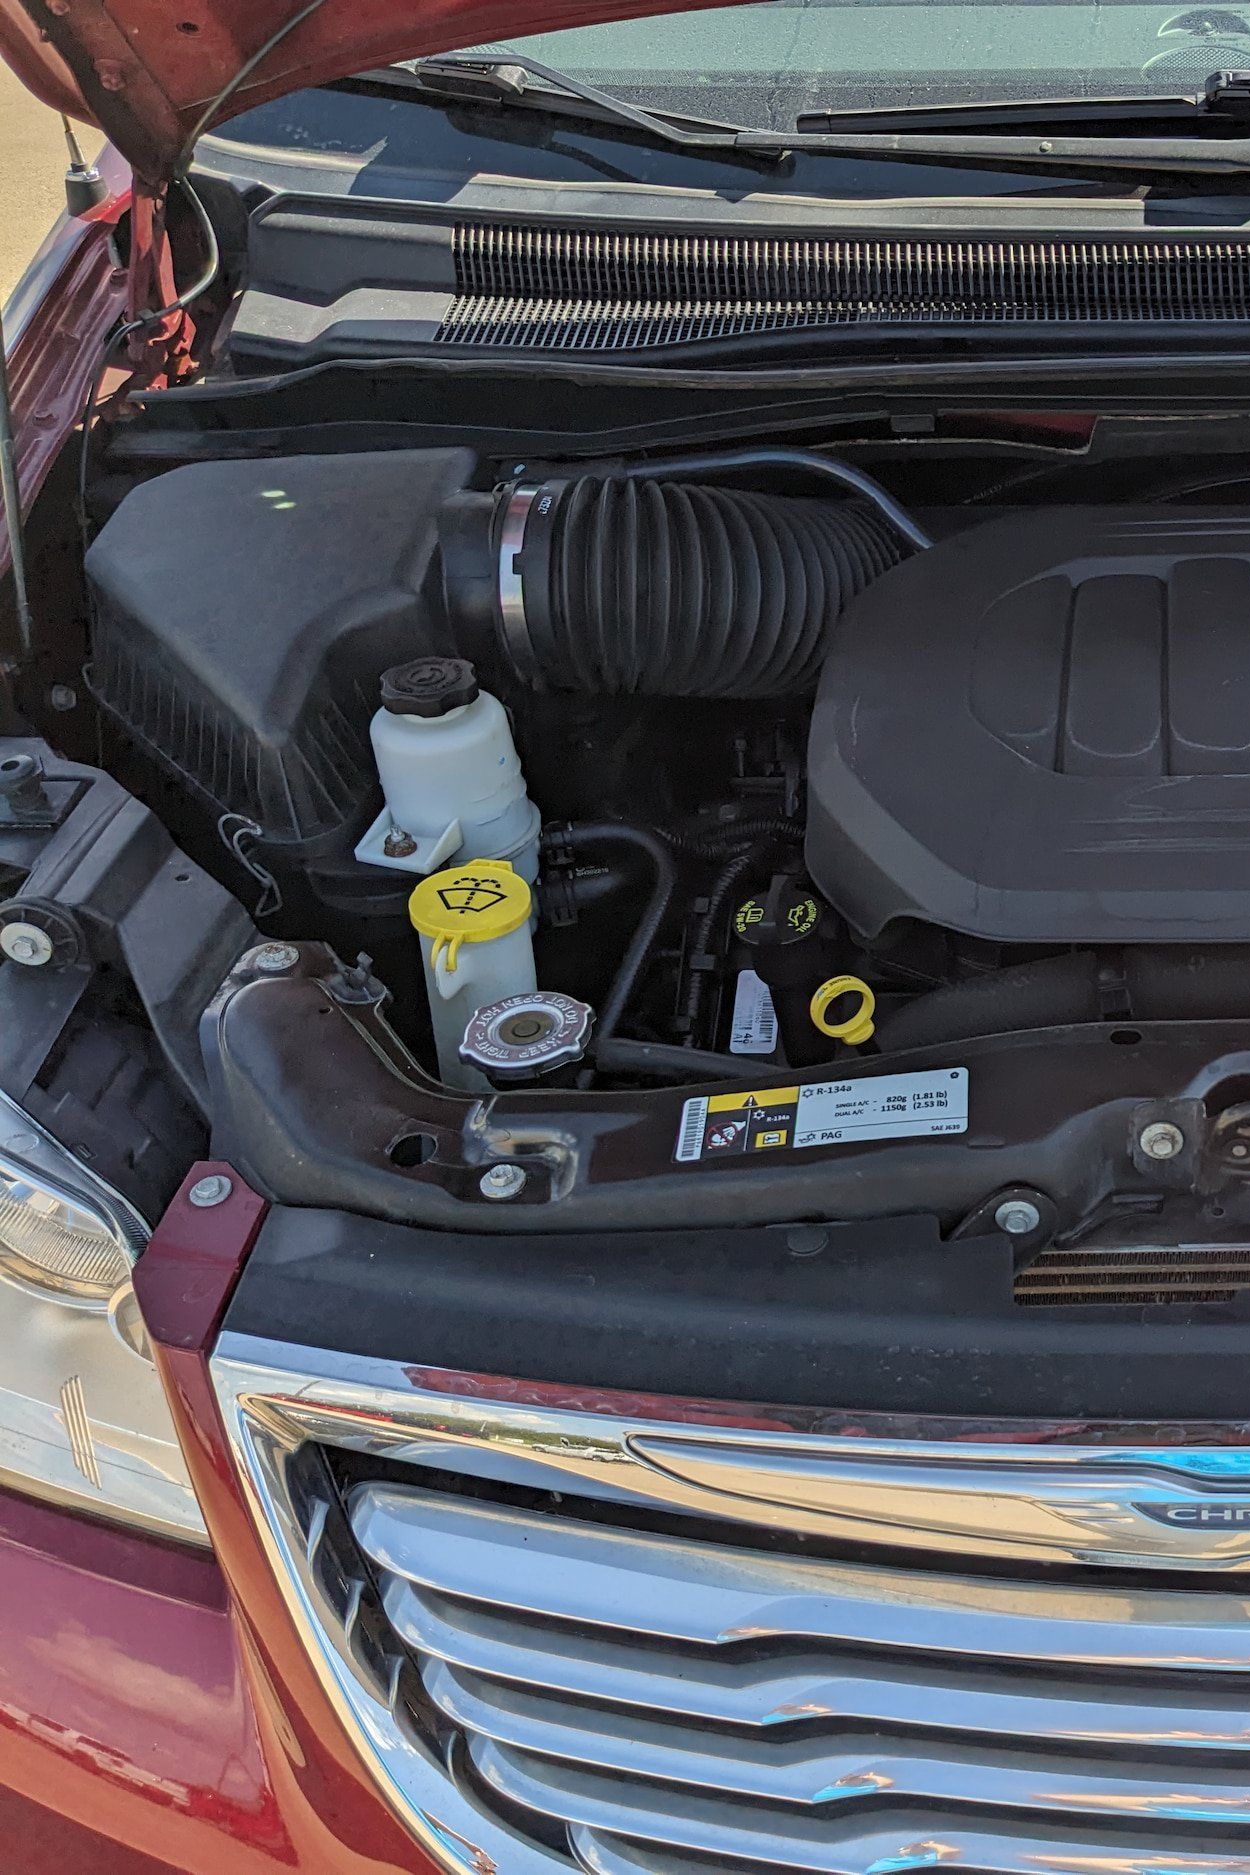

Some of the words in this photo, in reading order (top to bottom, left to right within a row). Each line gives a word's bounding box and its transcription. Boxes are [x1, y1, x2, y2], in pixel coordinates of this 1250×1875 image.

[740, 900, 756, 912] SAE
[805, 900, 817, 922] ENGINE
[795, 922, 811, 932] OIL
[502, 995, 543, 1009] OPEN
[546, 996, 574, 1011] NOT
[476, 1006, 502, 1027] HOT
[565, 1010, 578, 1024] DO
[475, 1040, 510, 1058] TIGHT
[519, 1038, 561, 1058] KEEP
[816, 1085, 852, 1095] R-134a
[912, 1092, 934, 1101] (1.81
[881, 1104, 907, 1112] 1150g
[913, 1101, 934, 1110] (2.53
[937, 1100, 948, 1108] lb)
[767, 1114, 790, 1122] R-134a
[821, 1131, 842, 1140] PAG
